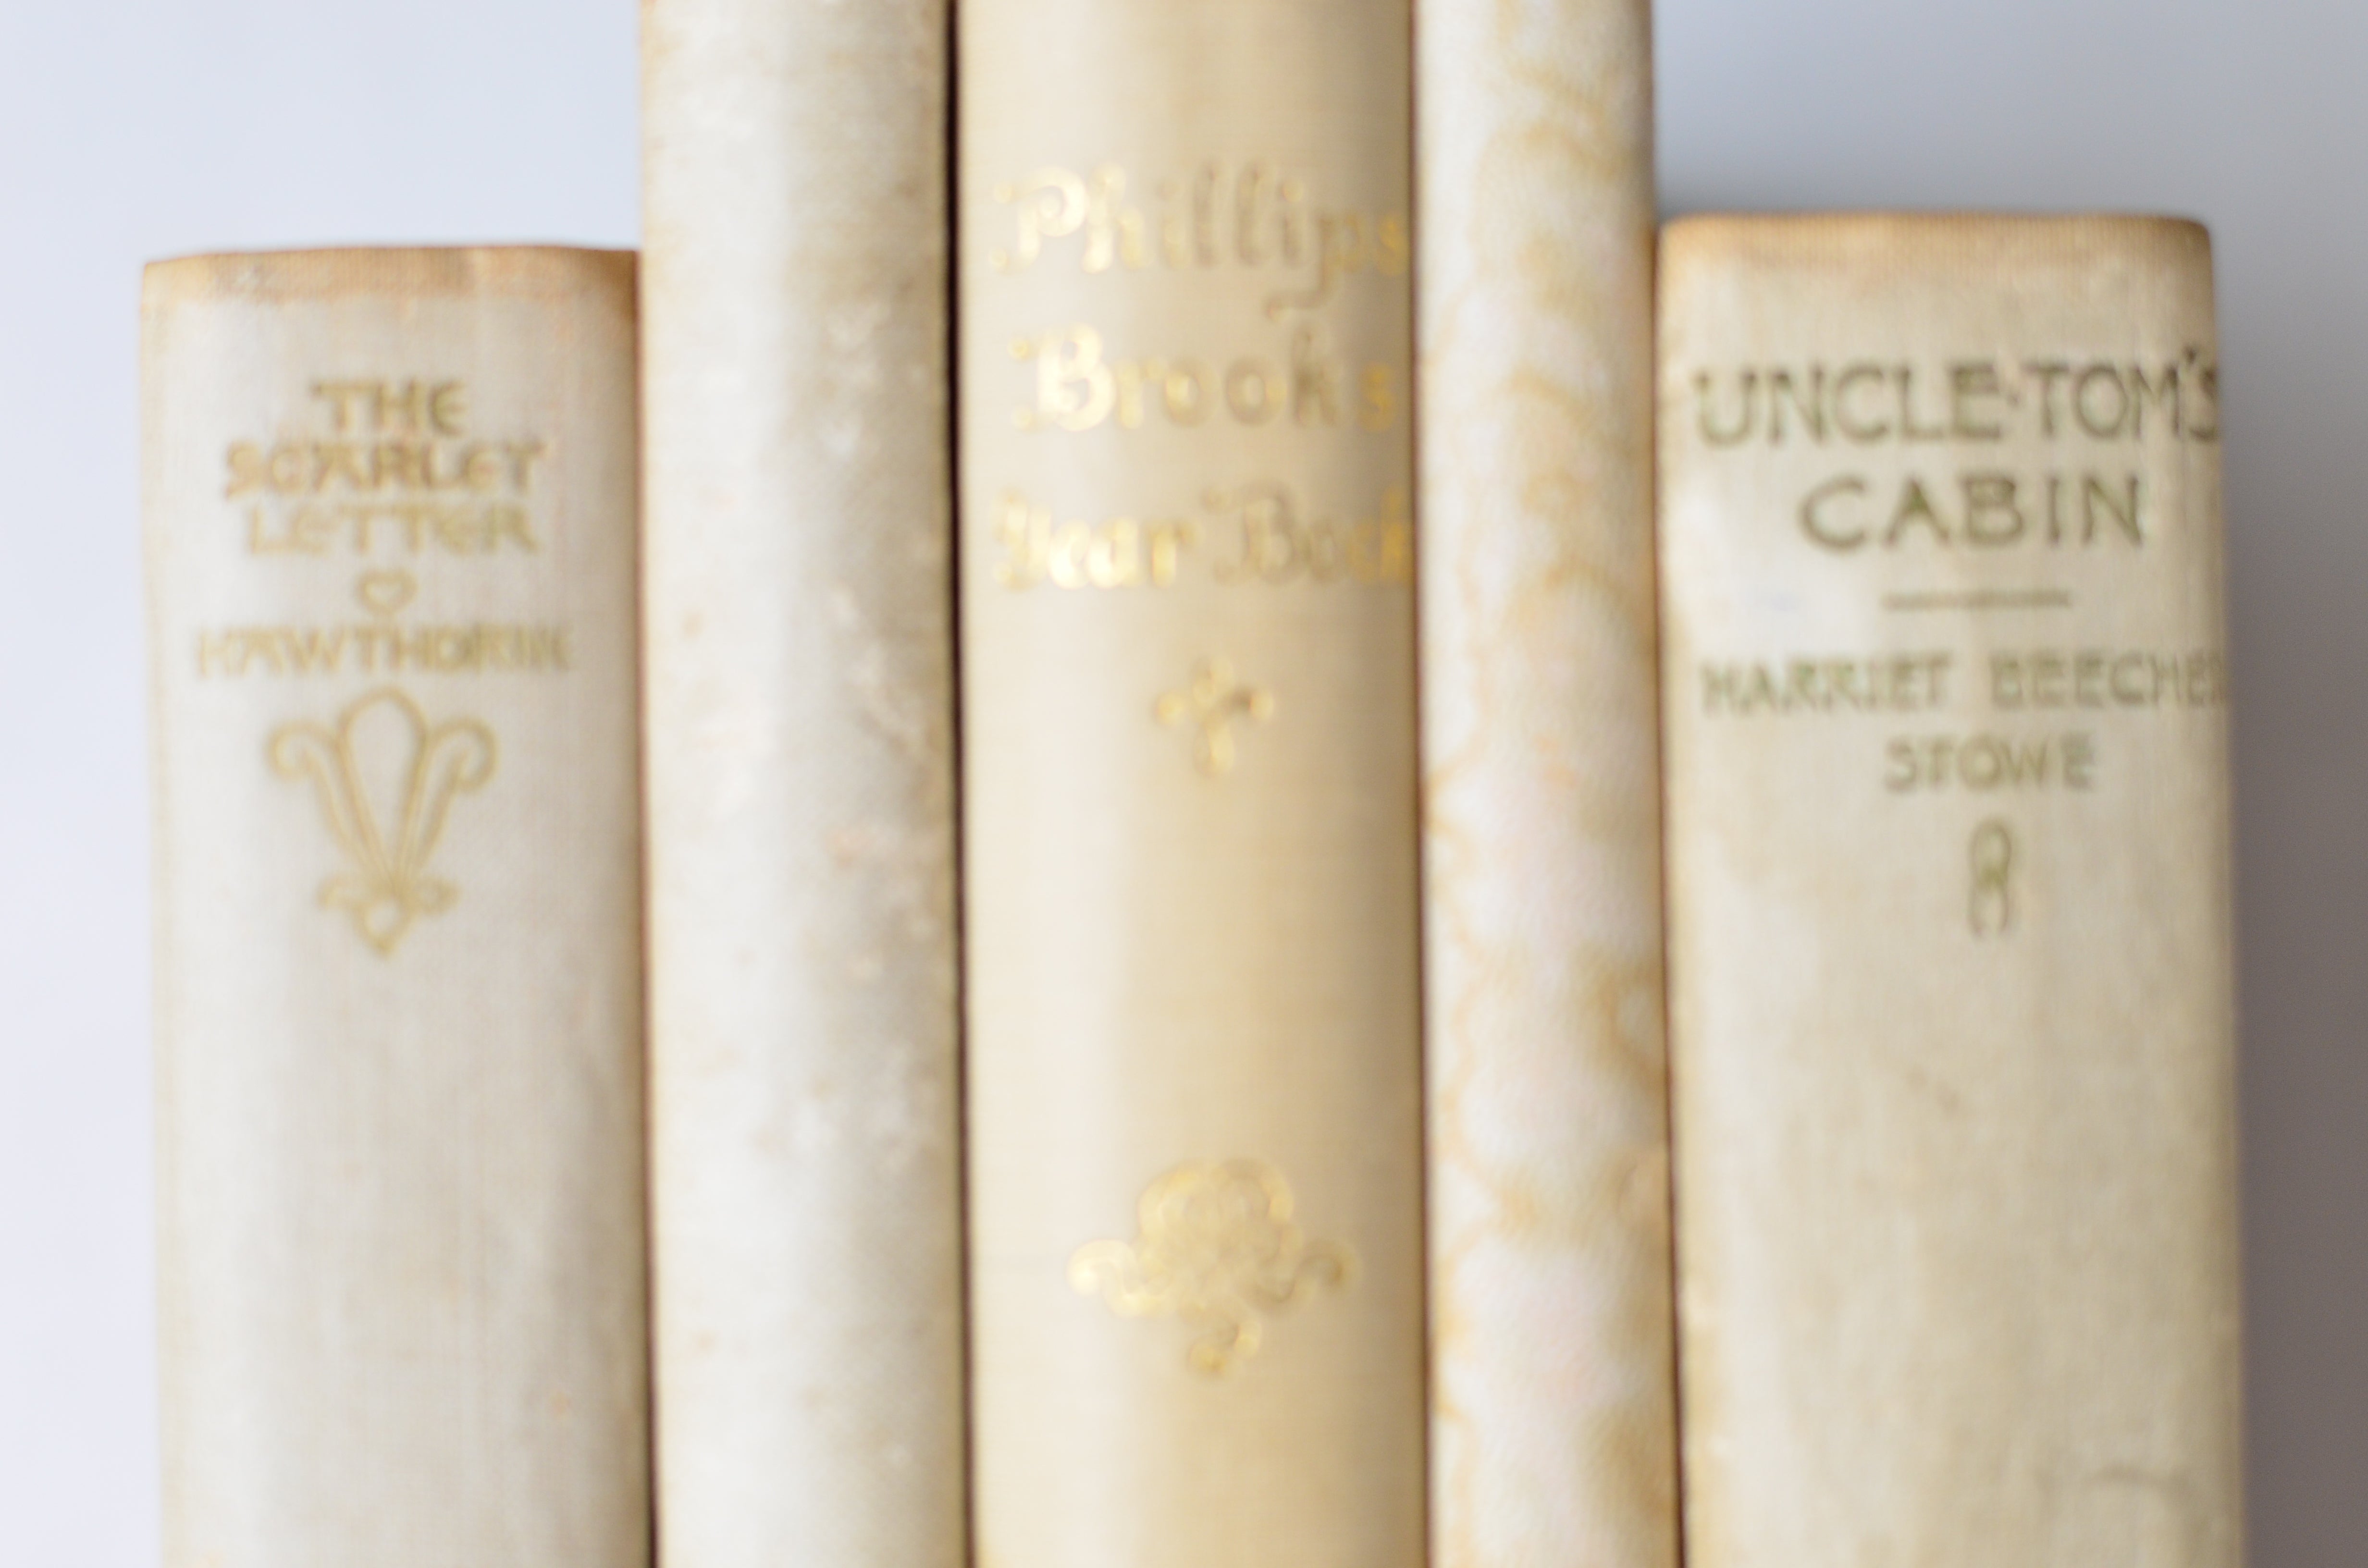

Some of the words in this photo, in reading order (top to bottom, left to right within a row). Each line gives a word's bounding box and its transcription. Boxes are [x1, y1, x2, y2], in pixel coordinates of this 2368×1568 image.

[990, 161, 1408, 322] Phillips
[1009, 320, 1398, 432] Brooks
[313, 382, 464, 433] THE
[228, 442, 545, 497] SCARLET
[252, 506, 538, 553] LETTER
[1802, 476, 2140, 549] CABIN
[1702, 651, 1950, 712] HARRIET
[1887, 735, 2092, 790] STOWE
